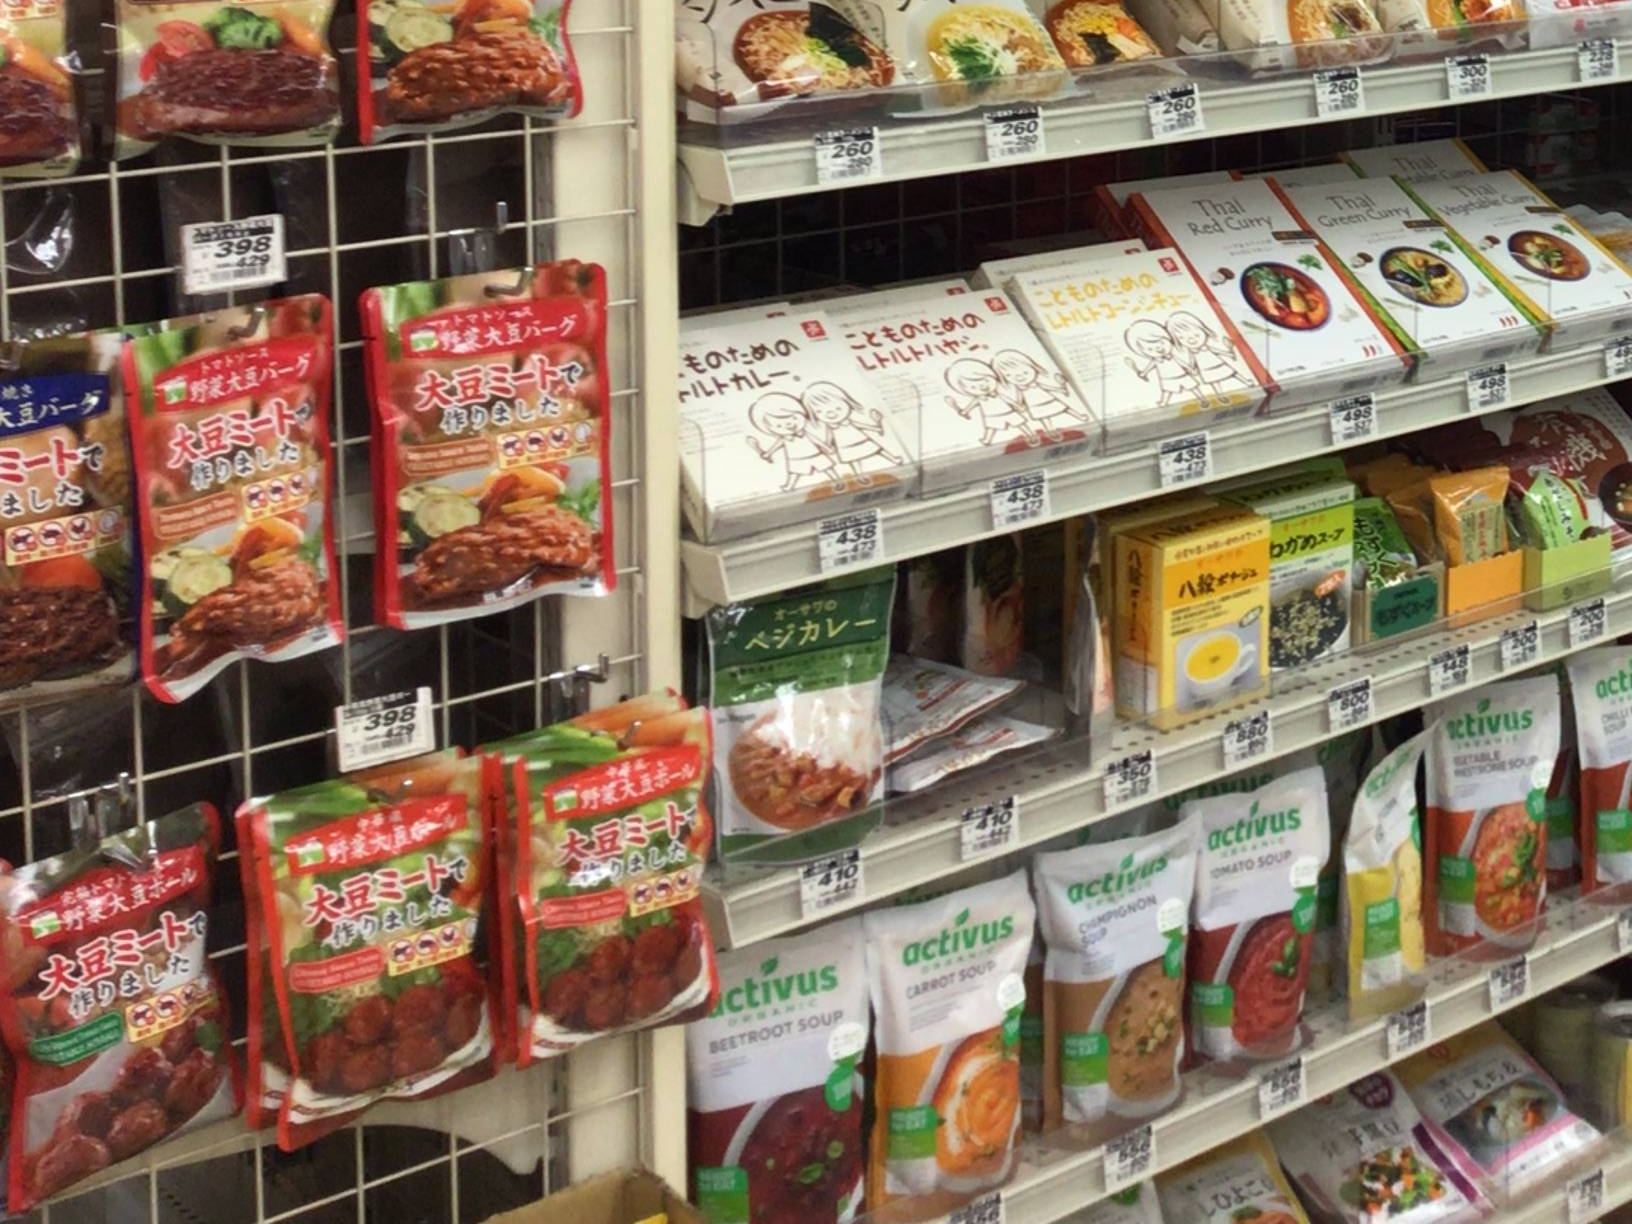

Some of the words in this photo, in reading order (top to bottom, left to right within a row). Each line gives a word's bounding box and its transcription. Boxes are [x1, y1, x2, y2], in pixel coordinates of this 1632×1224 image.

[1461, 66, 1487, 77] 300
[1329, 80, 1358, 93] 260
[1163, 98, 1194, 113] 260
[1002, 121, 1037, 135] 260
[833, 142, 872, 158] 260
[1452, 182, 1499, 199] Thai
[1193, 197, 1246, 218] Thai
[1326, 193, 1376, 212] Thai
[1189, 220, 1225, 237] Red
[1226, 214, 1275, 233] Curry
[1317, 212, 1368, 229] Green
[1369, 206, 1412, 224] Curry
[213, 237, 272, 258] 398
[415, 353, 583, 411] 大豆ミートで
[440, 395, 560, 435] 作りました
[1343, 408, 1372, 423] 498
[191, 439, 299, 490] 作りました
[1173, 448, 1206, 463] 438
[1008, 486, 1043, 504] 438
[837, 527, 876, 545] 438
[745, 618, 877, 649] ベジカレー
[363, 707, 417, 729] 398
[976, 811, 1012, 831] 410
[1207, 806, 1302, 851] activus
[1258, 849, 1292, 867] SOUP
[818, 866, 858, 887] 410
[1067, 856, 1168, 904] activus
[304, 854, 469, 925] 大豆ミートで
[329, 894, 452, 948] 作りました
[902, 912, 1013, 967] activus
[37, 911, 207, 1001] 大豆ミートで
[69, 954, 190, 1020] 作りました
[906, 973, 955, 1000] CARROT
[959, 960, 997, 981] SOUP
[709, 1022, 793, 1055] BEETROOT
[798, 1010, 844, 1033] SOUP
